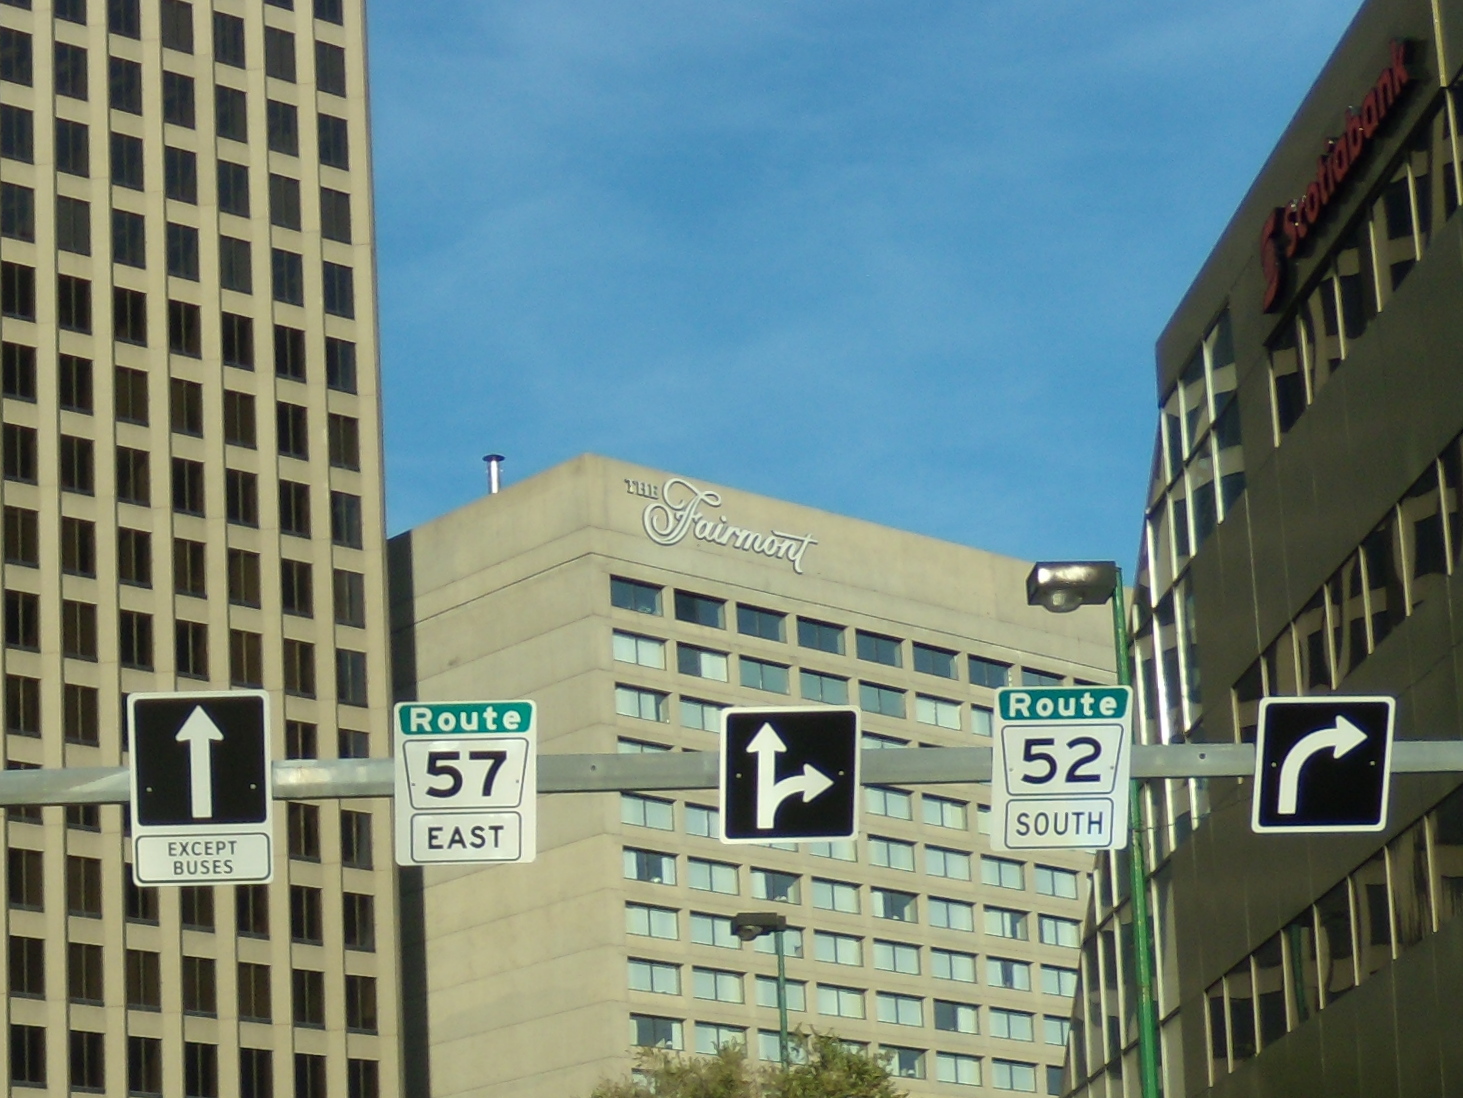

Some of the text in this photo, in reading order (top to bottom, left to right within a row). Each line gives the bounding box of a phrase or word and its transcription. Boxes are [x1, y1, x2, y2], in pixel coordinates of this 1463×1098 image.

[1283, 38, 1410, 259] Scotiabank
[624, 478, 659, 500] THE
[642, 477, 818, 574] Fairmont
[1008, 691, 1118, 718] Route
[409, 706, 522, 732] Route
[1021, 736, 1102, 785] 52
[425, 750, 507, 798] 57
[1015, 811, 1103, 836] SOUTH
[167, 840, 238, 857] EXCEPT
[427, 825, 504, 850] EAST
[173, 859, 234, 876] BUSES
